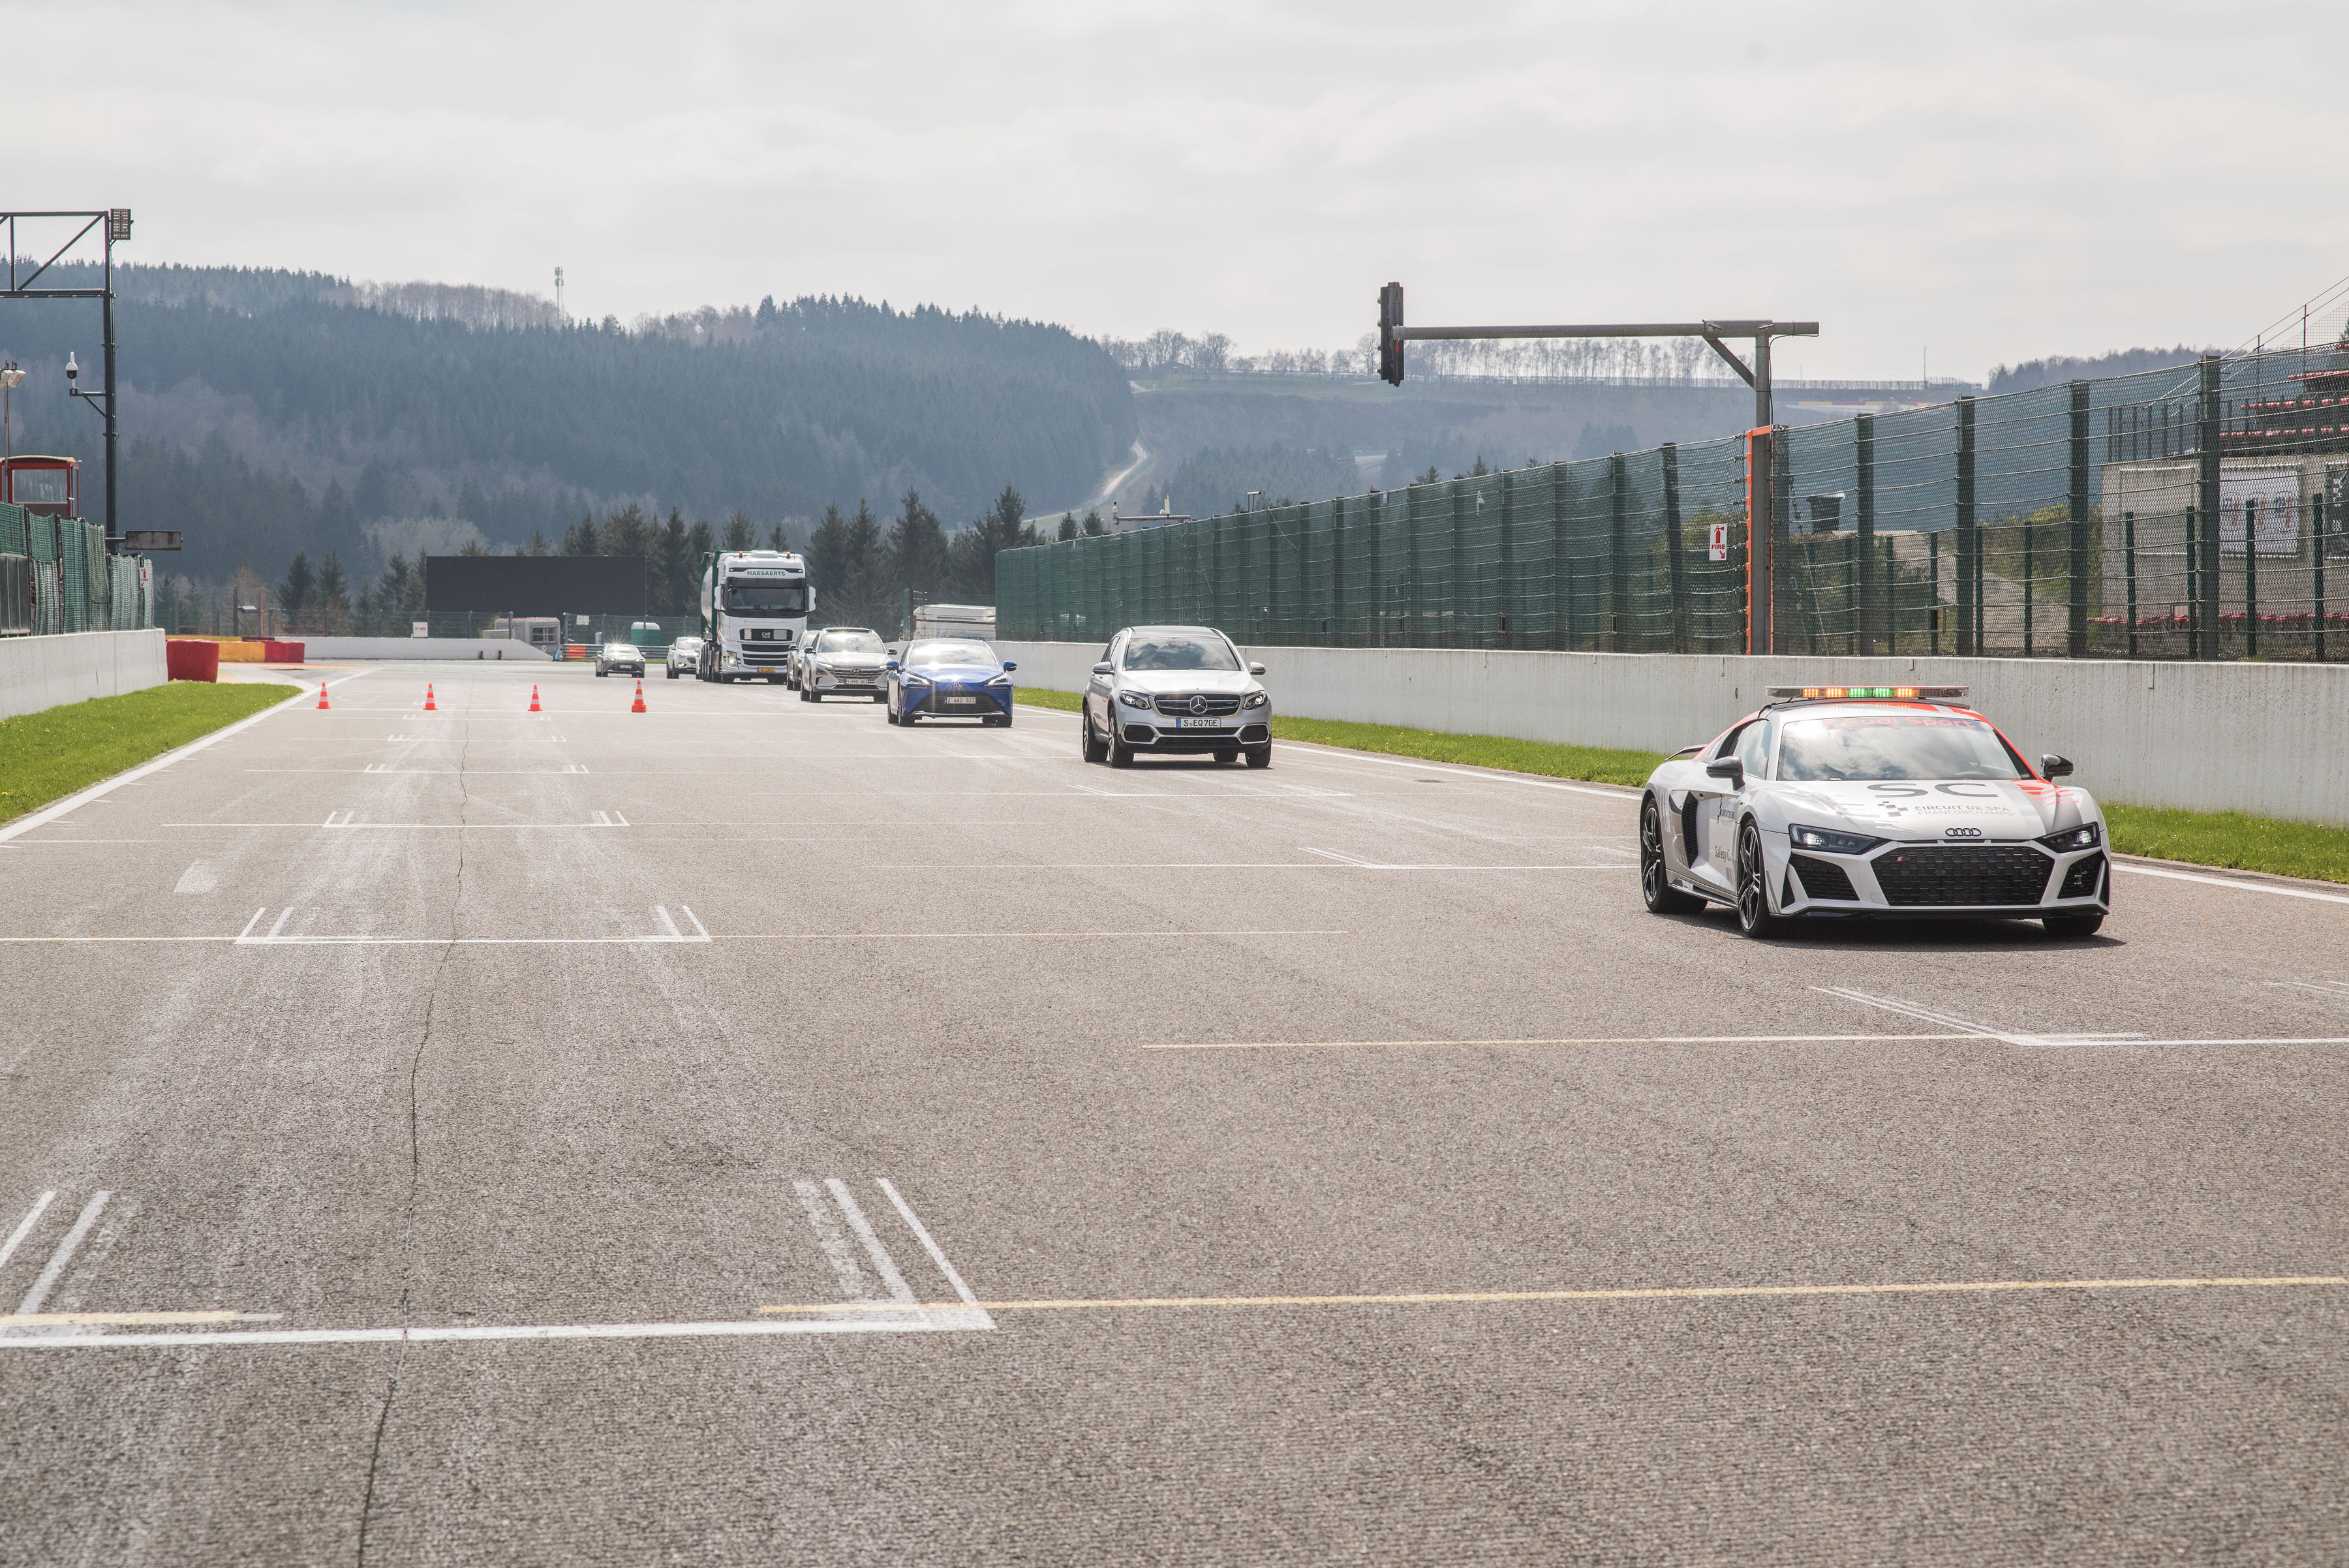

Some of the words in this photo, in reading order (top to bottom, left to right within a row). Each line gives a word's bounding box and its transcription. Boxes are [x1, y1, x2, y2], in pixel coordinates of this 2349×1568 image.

[1841, 716, 1898, 726] Audi
[1905, 716, 1976, 728] Sport
[1867, 782, 1999, 798] SC
[1715, 846, 1727, 863] Safety
